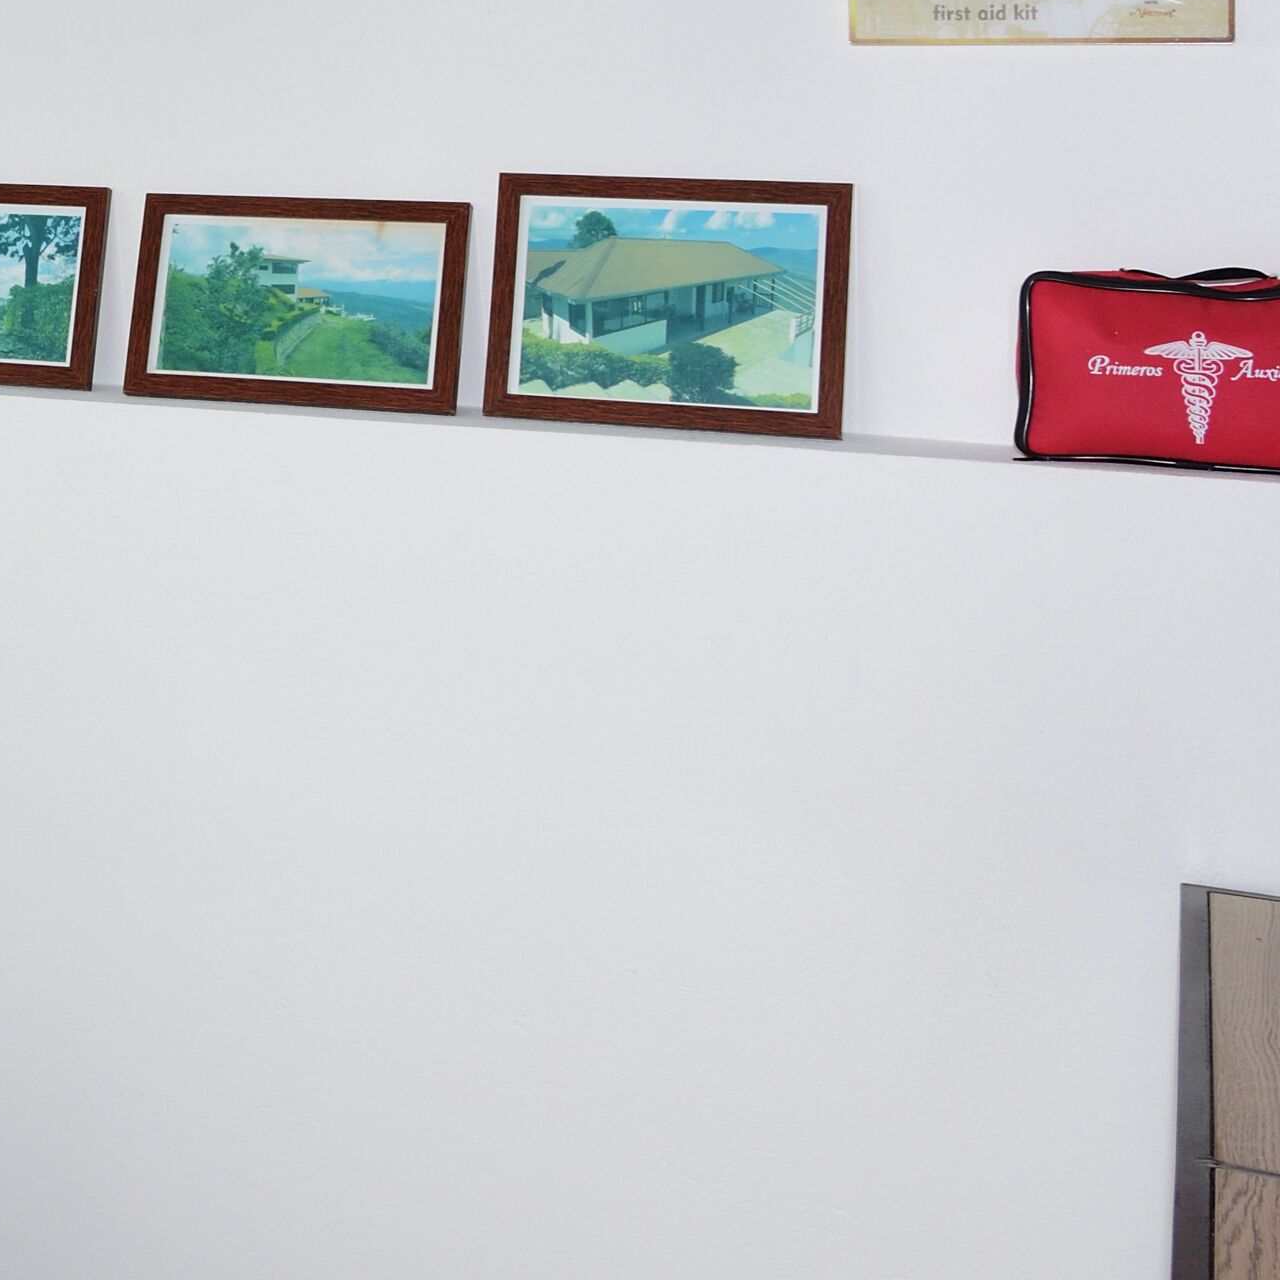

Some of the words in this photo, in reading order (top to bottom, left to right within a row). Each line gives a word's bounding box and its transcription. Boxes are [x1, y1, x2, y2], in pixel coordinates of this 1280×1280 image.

[933, 4, 971, 21] first
[977, 4, 1008, 21] aid
[1013, 4, 1038, 21] kit
[1088, 355, 1163, 377] Primeros
